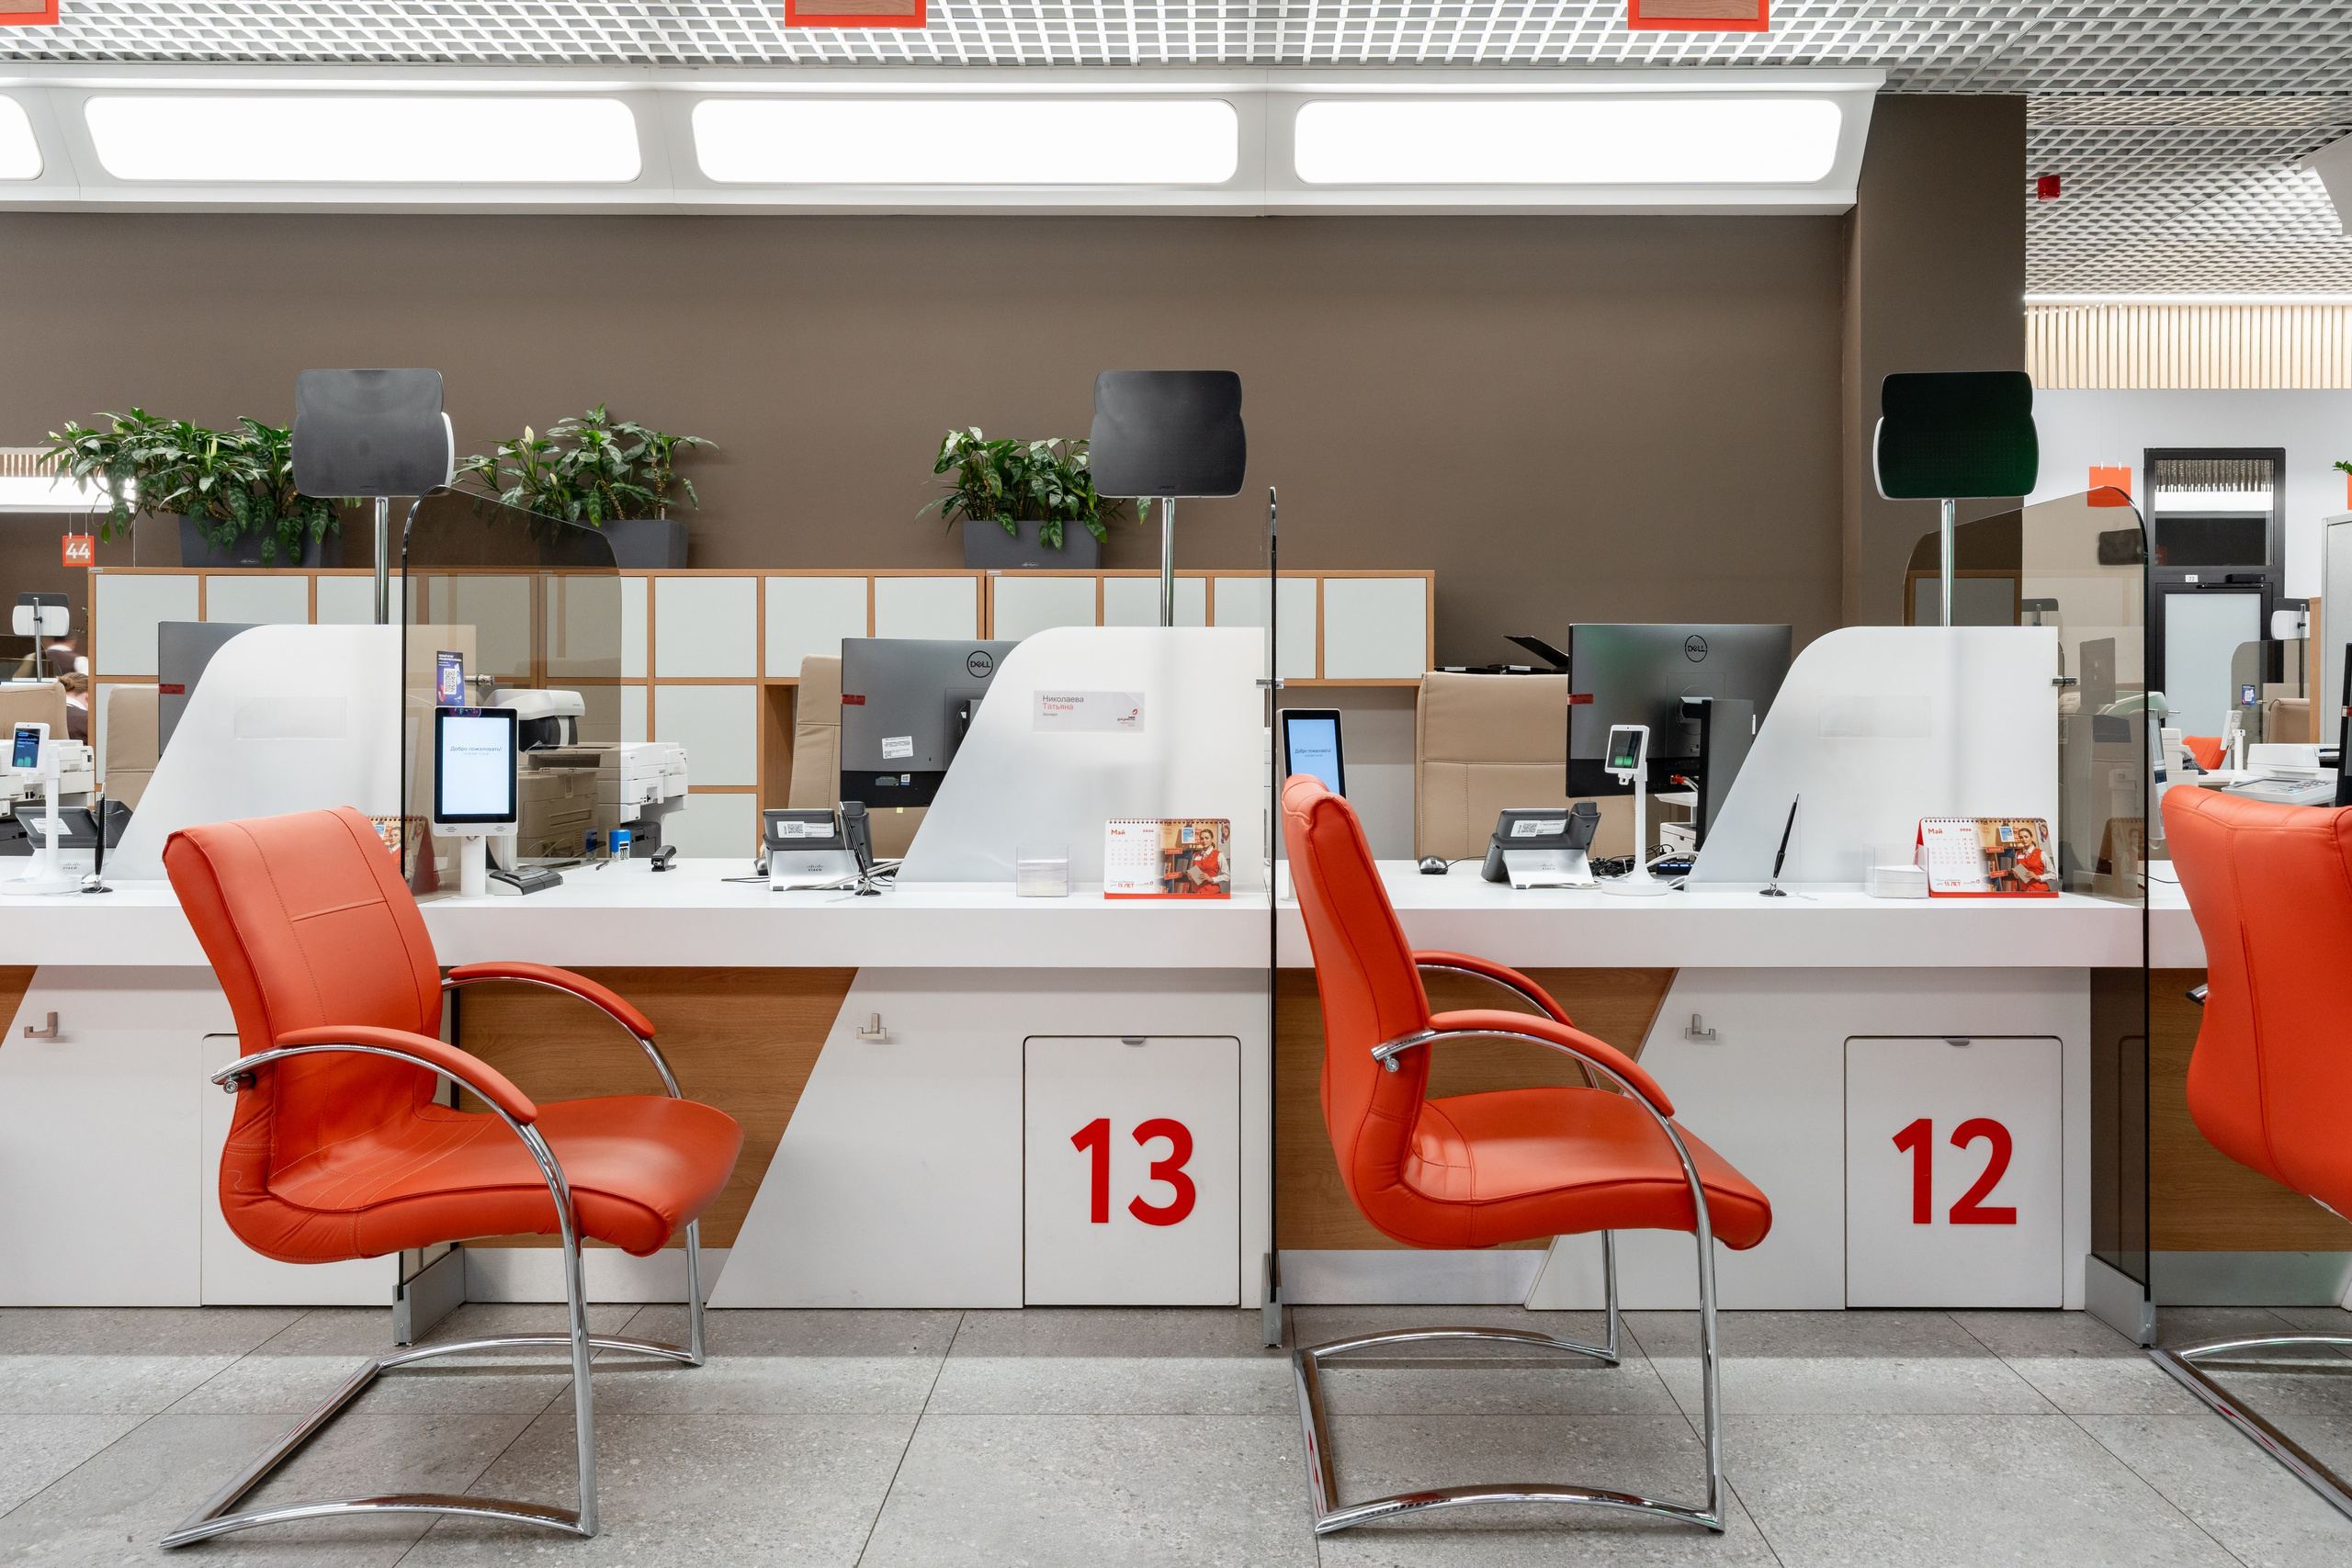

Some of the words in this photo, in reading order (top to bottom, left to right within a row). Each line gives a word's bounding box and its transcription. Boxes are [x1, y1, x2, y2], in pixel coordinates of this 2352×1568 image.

[65, 542, 91, 559] 44
[1042, 694, 1084, 703] Николаева
[1070, 1118, 1196, 1226] 13
[1892, 1118, 2017, 1224] 12
